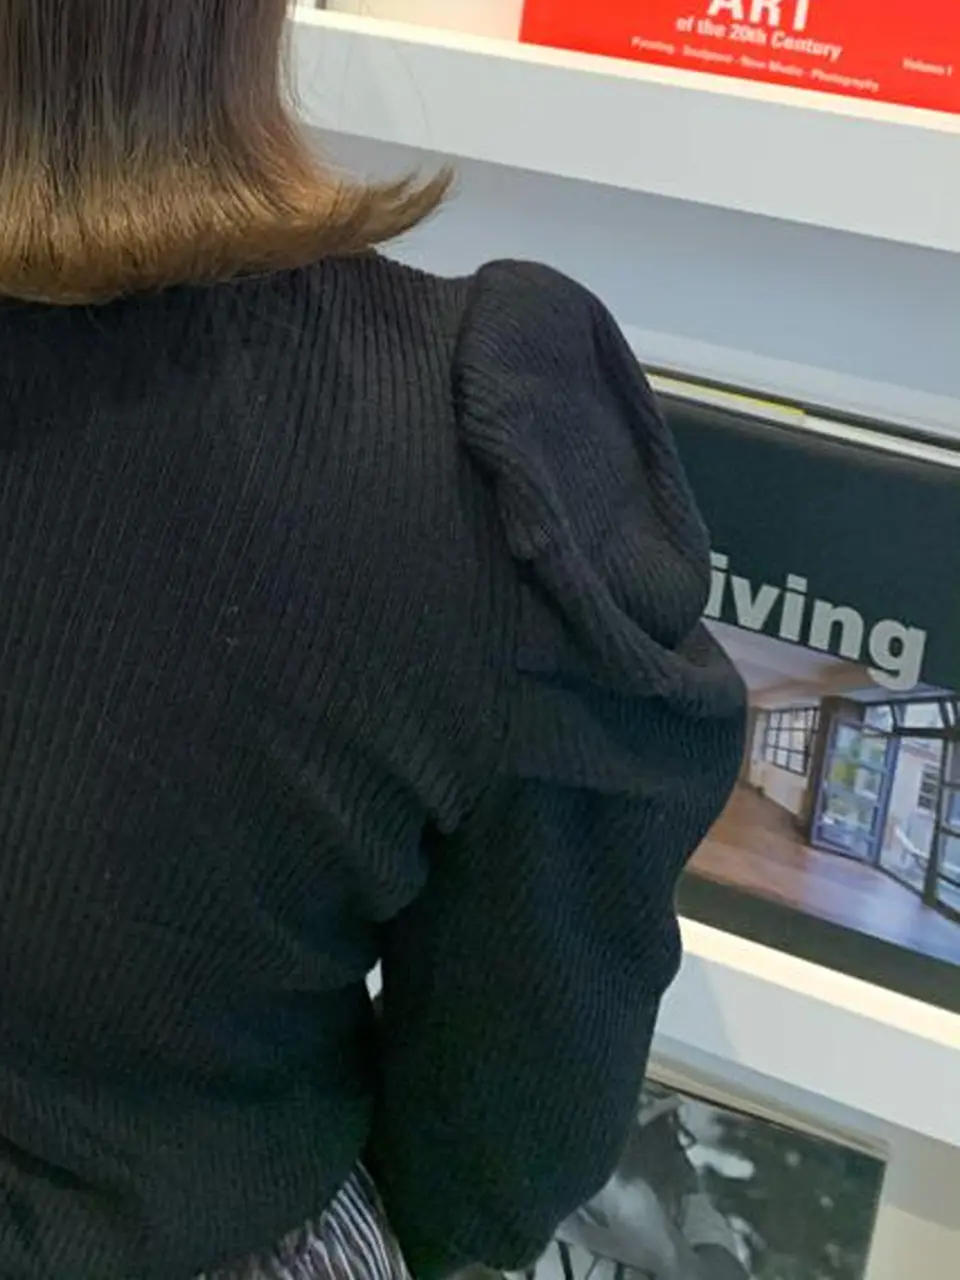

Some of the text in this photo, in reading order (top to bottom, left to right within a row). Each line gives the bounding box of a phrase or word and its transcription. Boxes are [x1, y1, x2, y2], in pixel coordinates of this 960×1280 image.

[676, 16, 843, 63] of the 20th Century
[702, 550, 927, 691] iving
